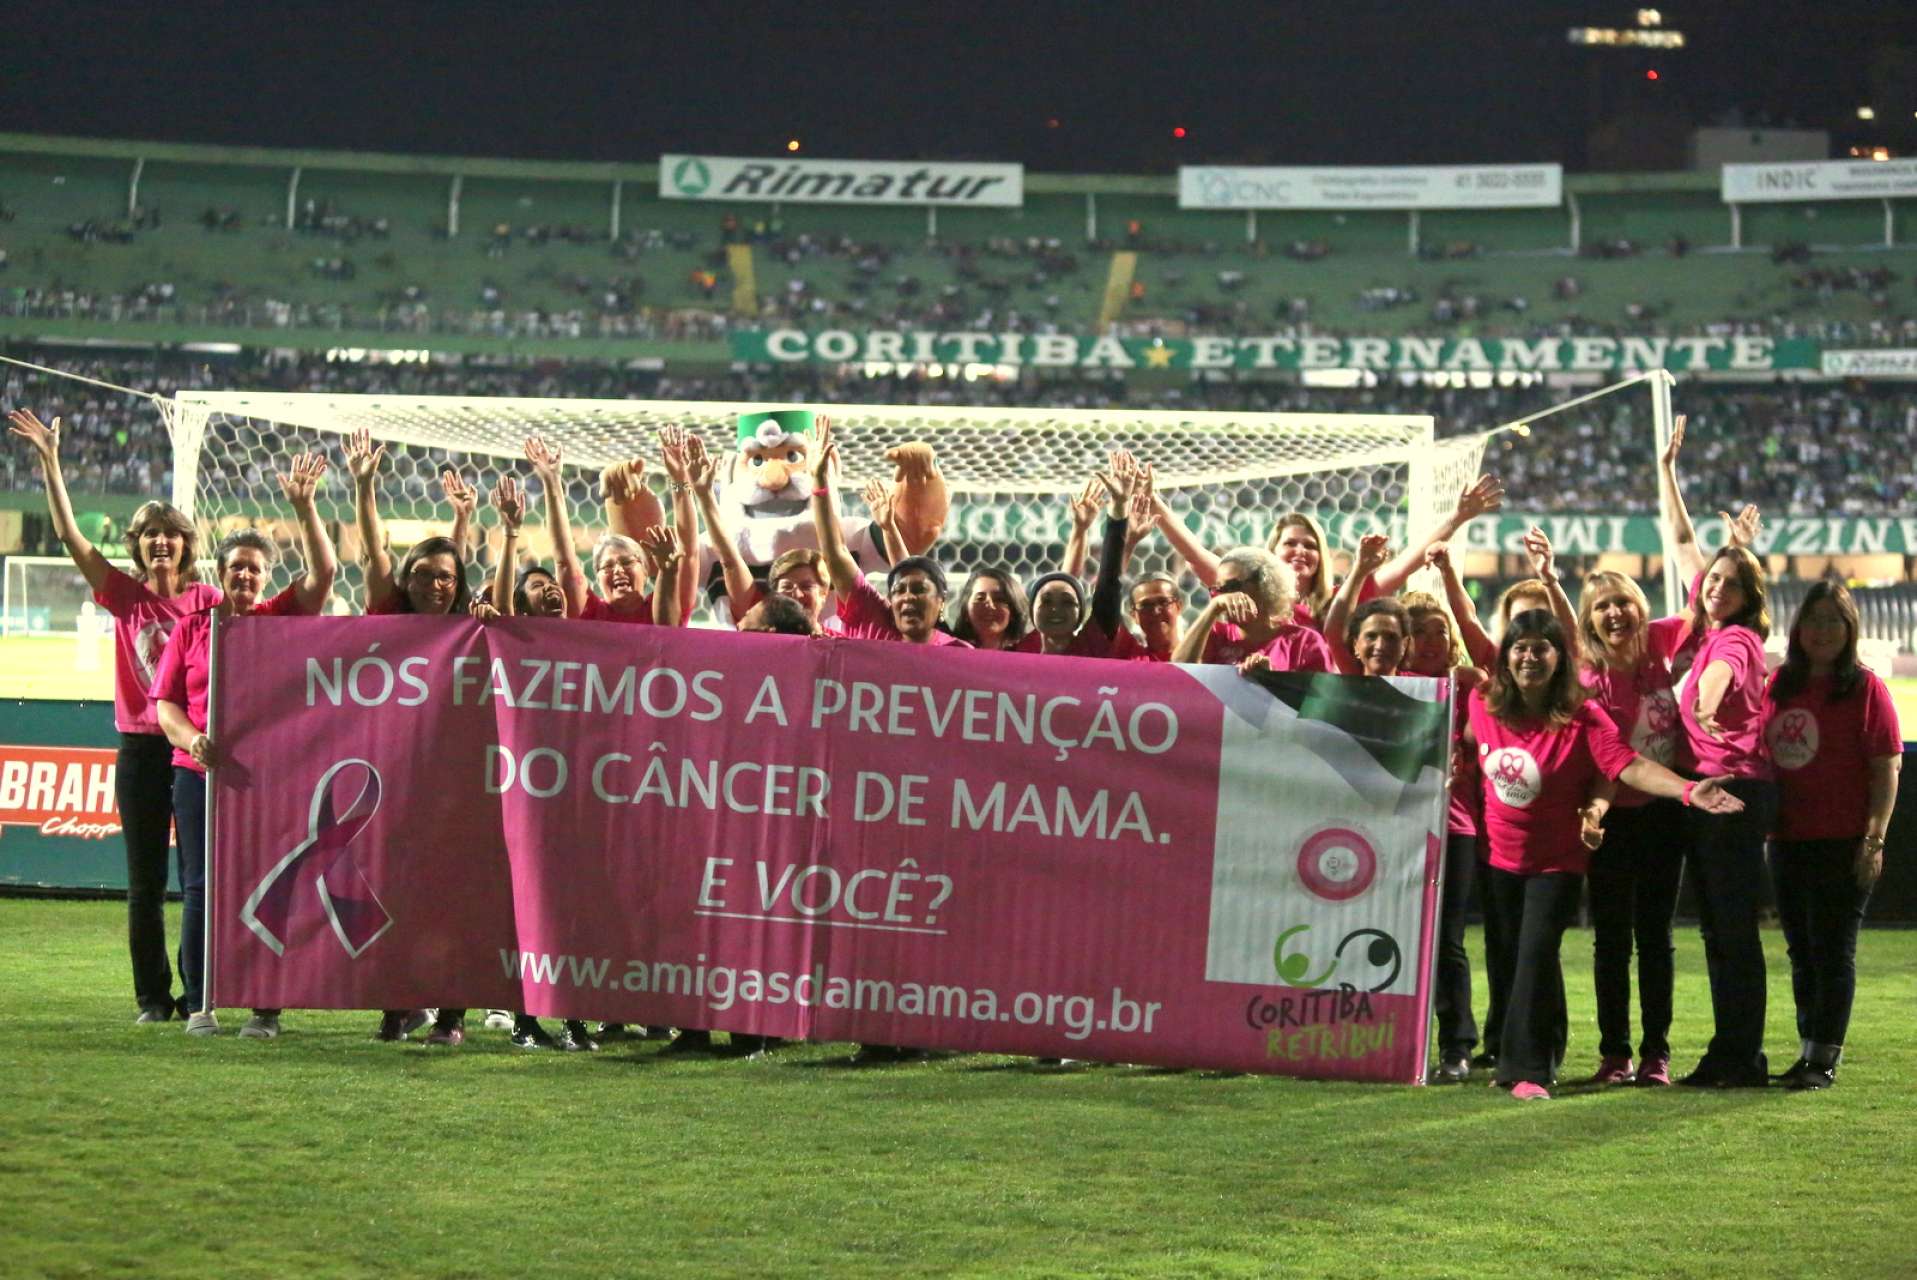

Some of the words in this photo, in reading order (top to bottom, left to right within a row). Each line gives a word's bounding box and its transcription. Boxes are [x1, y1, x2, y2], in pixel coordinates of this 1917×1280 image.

[723, 163, 1004, 199] Rimatur
[766, 329, 1135, 367] CORITIBA
[1190, 335, 1775, 369] ETERNAMENTE
[306, 643, 430, 707] NÓS
[453, 657, 723, 722] FAZEMOS
[744, 675, 789, 727] A
[811, 678, 1180, 762] PREVENÇÃO
[0, 760, 119, 814] BRAH
[484, 745, 568, 799] DO
[592, 742, 831, 819] CÂNCER
[853, 771, 929, 825] DE
[950, 778, 1171, 844] MAMA.
[698, 857, 734, 909] E
[756, 857, 953, 924] VOCÊ?
[499, 948, 1162, 1041] www.amigasdamama.org.br
[1246, 982, 1374, 1030] CORITIBA
